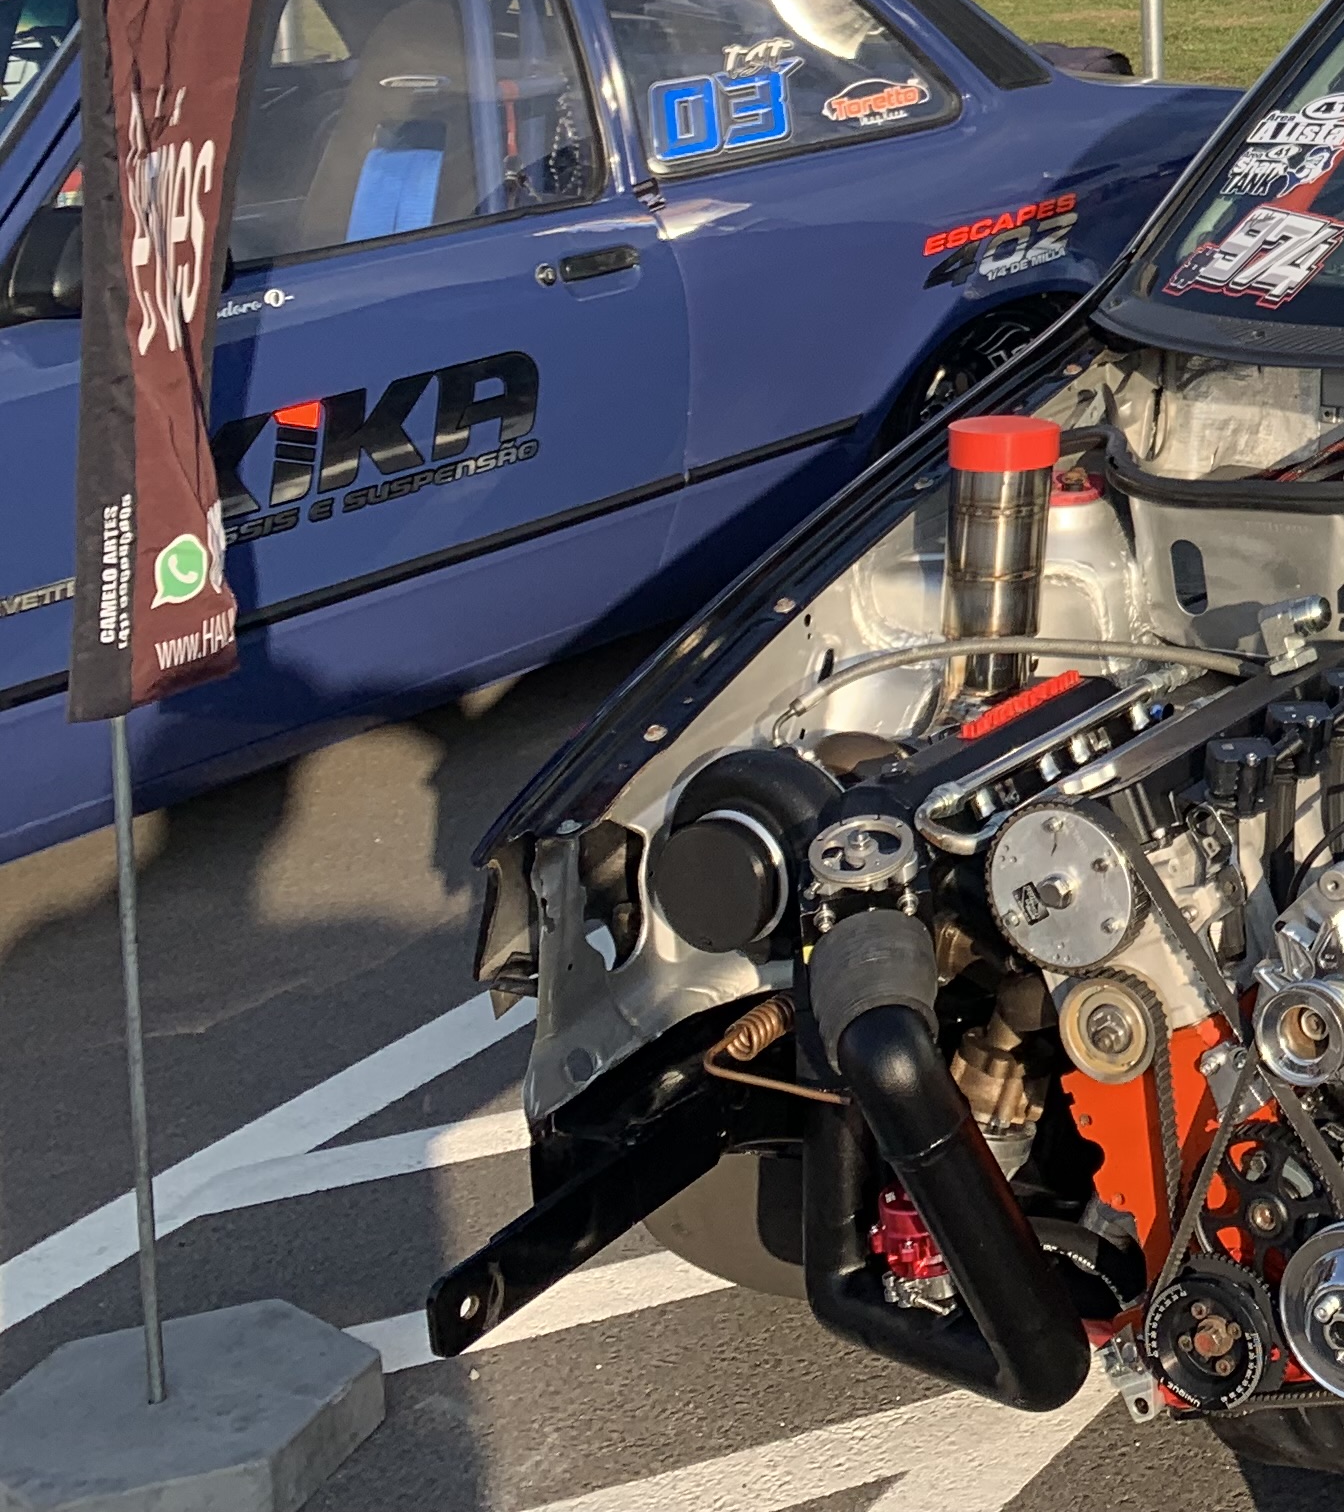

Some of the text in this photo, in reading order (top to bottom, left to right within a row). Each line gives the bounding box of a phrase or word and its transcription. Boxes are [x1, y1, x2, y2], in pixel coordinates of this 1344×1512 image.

[831, 85, 921, 121] Toretto
[1273, 148, 1292, 157] 41
[923, 192, 1077, 256] ESCAPES
[923, 212, 1078, 290] 402
[1010, 257, 1028, 274] DE
[1031, 247, 1066, 267] MILLA
[100, 505, 119, 644] CAMELO ARTES
